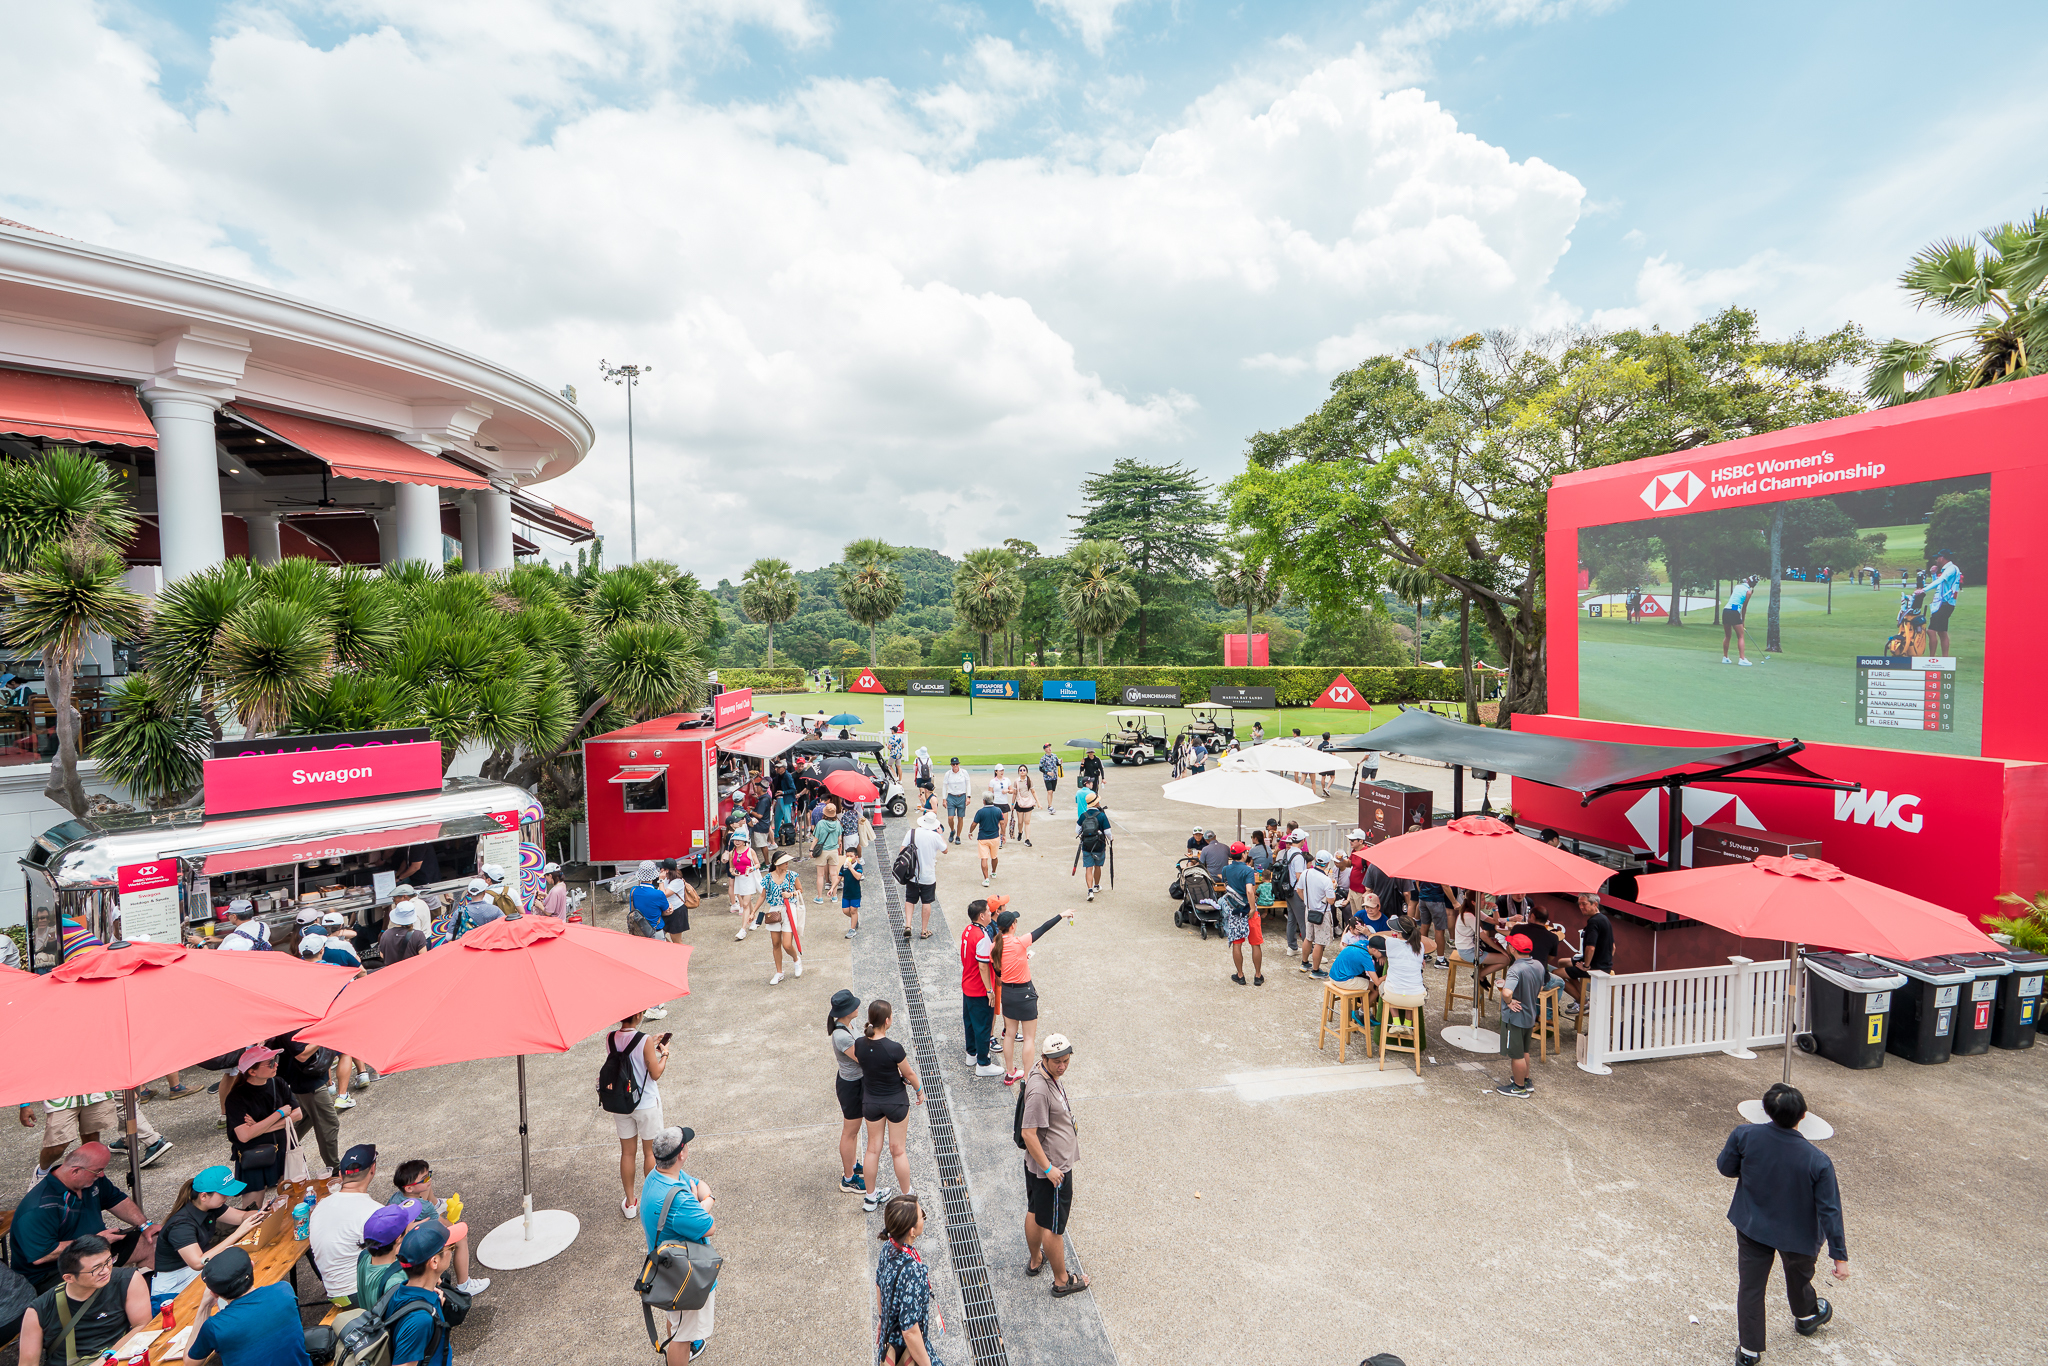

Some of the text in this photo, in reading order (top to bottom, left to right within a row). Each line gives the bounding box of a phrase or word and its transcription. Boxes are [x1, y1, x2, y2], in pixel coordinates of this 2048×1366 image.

[1711, 450, 1834, 482] HSBC Women's
[1711, 462, 1886, 498] World Championship
[292, 767, 373, 785] Swagon
[1834, 788, 1923, 834] IMG
